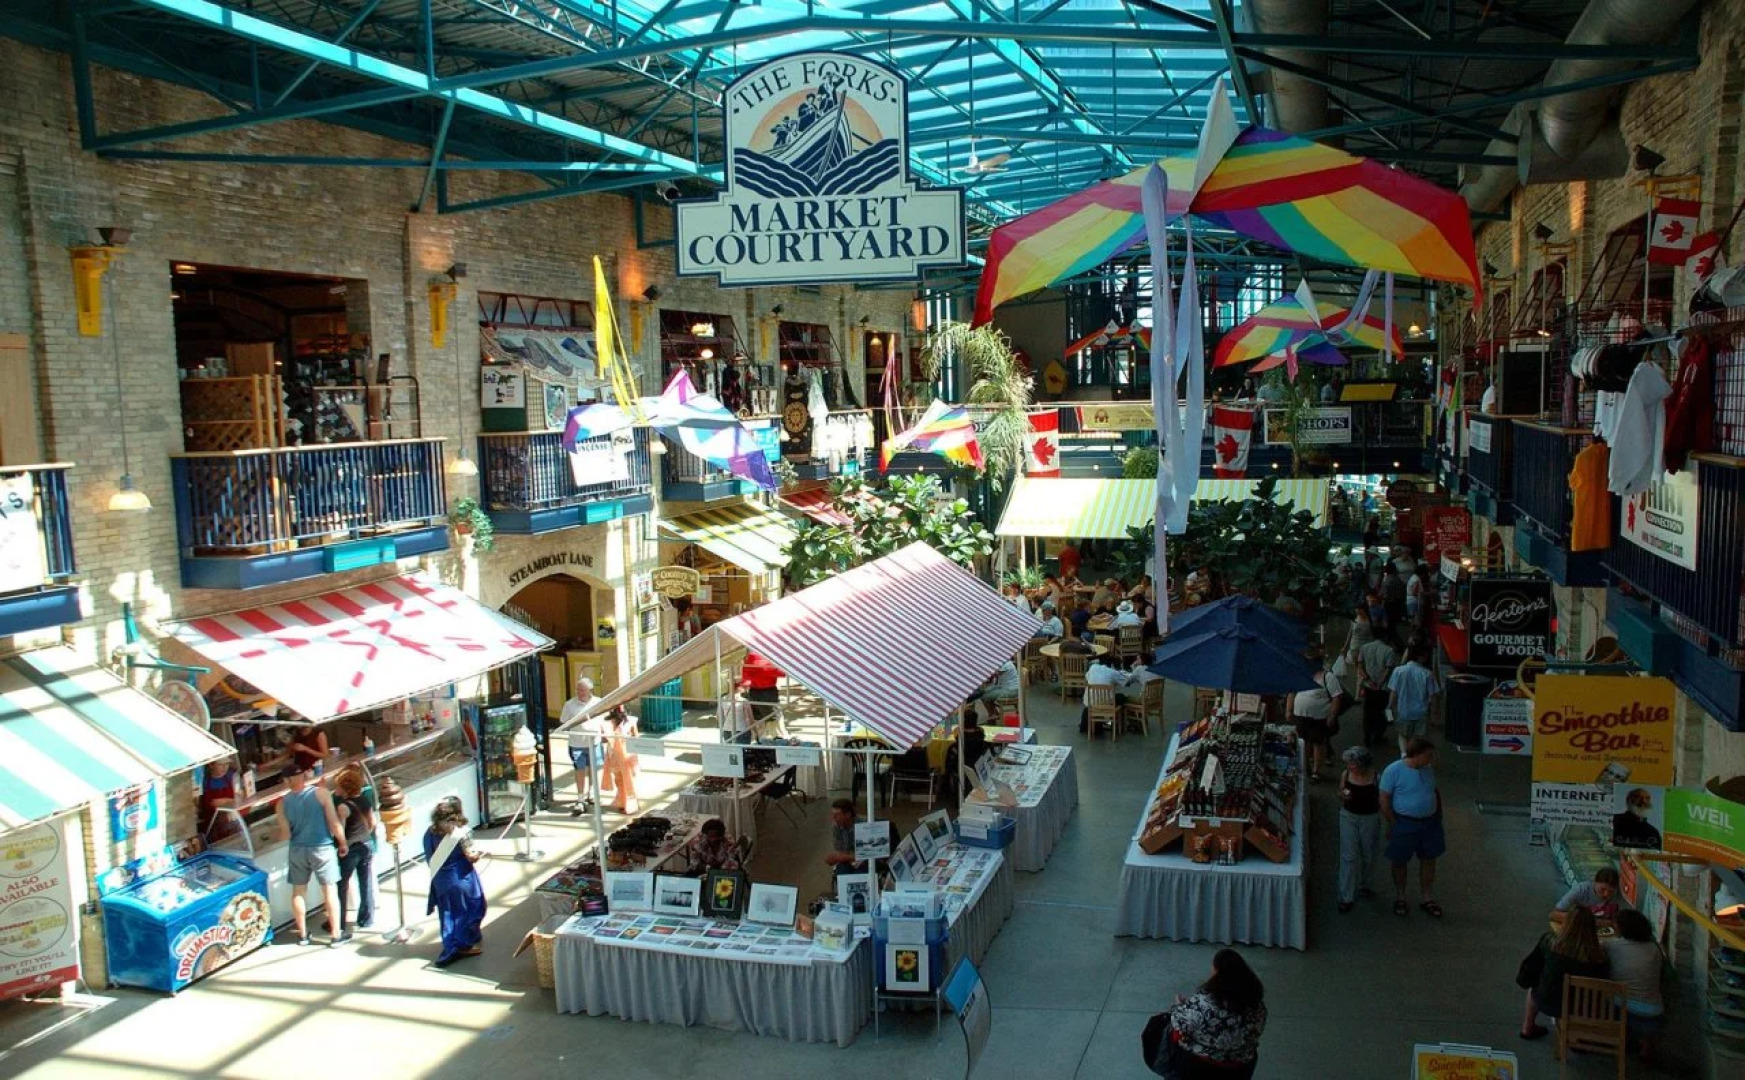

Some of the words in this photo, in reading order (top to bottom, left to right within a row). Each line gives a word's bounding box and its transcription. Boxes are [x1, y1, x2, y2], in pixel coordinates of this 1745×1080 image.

[734, 67, 791, 109] THE
[802, 60, 895, 103] FORKS
[729, 195, 907, 232] MARKET
[689, 225, 950, 265] COURTYARD
[1299, 418, 1346, 430] SHOPS
[509, 551, 567, 587] STEAMBOAT
[569, 551, 594, 568] LANE
[1472, 596, 1549, 631] Fenton's
[1473, 633, 1546, 646] GOURMET
[1496, 645, 1546, 656] FOODS
[1538, 701, 1670, 735] Smoothie
[1569, 729, 1640, 753] Bar
[1536, 789, 1607, 802] INTERNET
[1687, 802, 1735, 831] WEIL
[0, 877, 59, 905] VAILABLE
[7, 875, 39, 893] ALSO
[178, 925, 234, 979] DRUMSTICK
